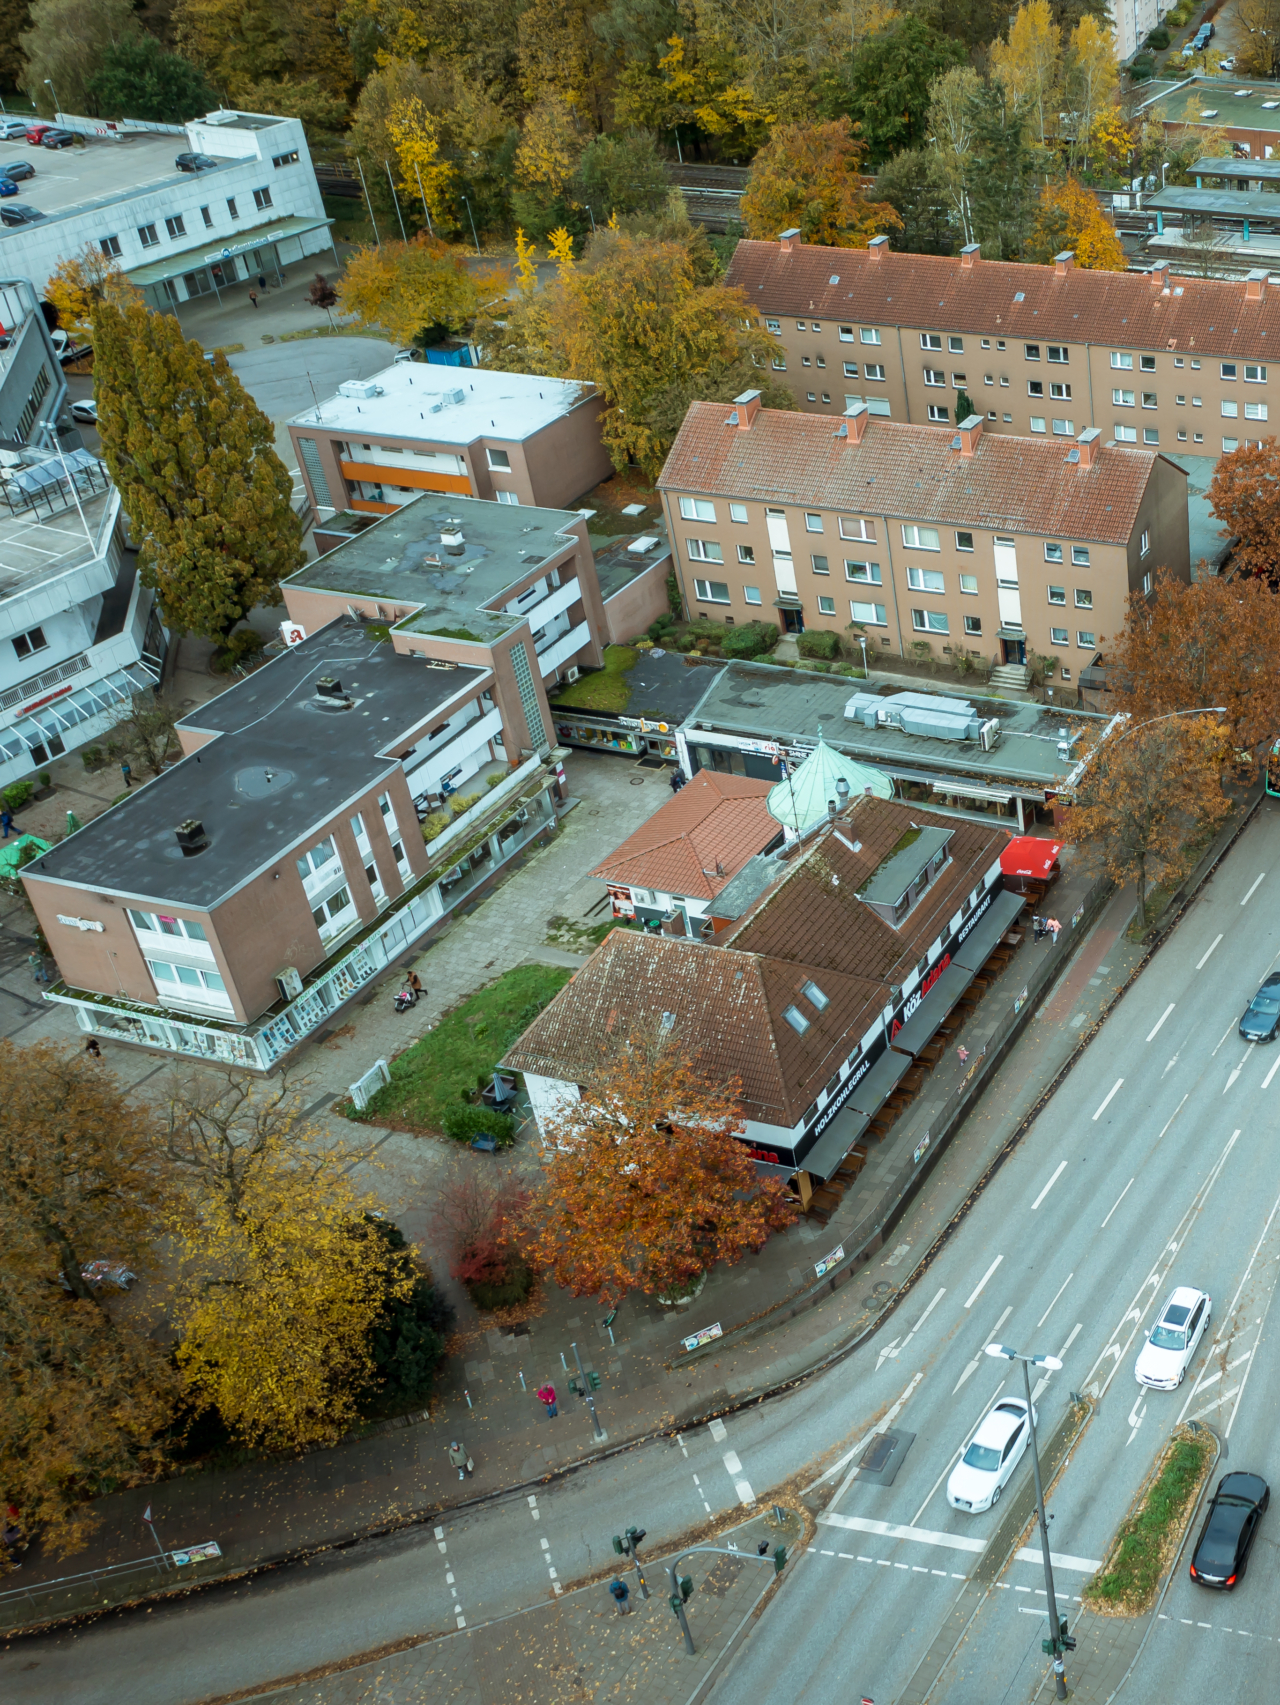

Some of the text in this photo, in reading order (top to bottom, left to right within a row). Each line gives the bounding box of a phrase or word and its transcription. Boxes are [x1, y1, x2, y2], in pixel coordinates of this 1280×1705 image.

[958, 894, 991, 943] RESTAURANT
[296, 989, 311, 1005] Über
[330, 955, 352, 975] Bücher
[367, 930, 381, 944] Euro
[921, 952, 951, 998] Adana
[814, 1059, 871, 1137] HOLZKOHLEGRILL
